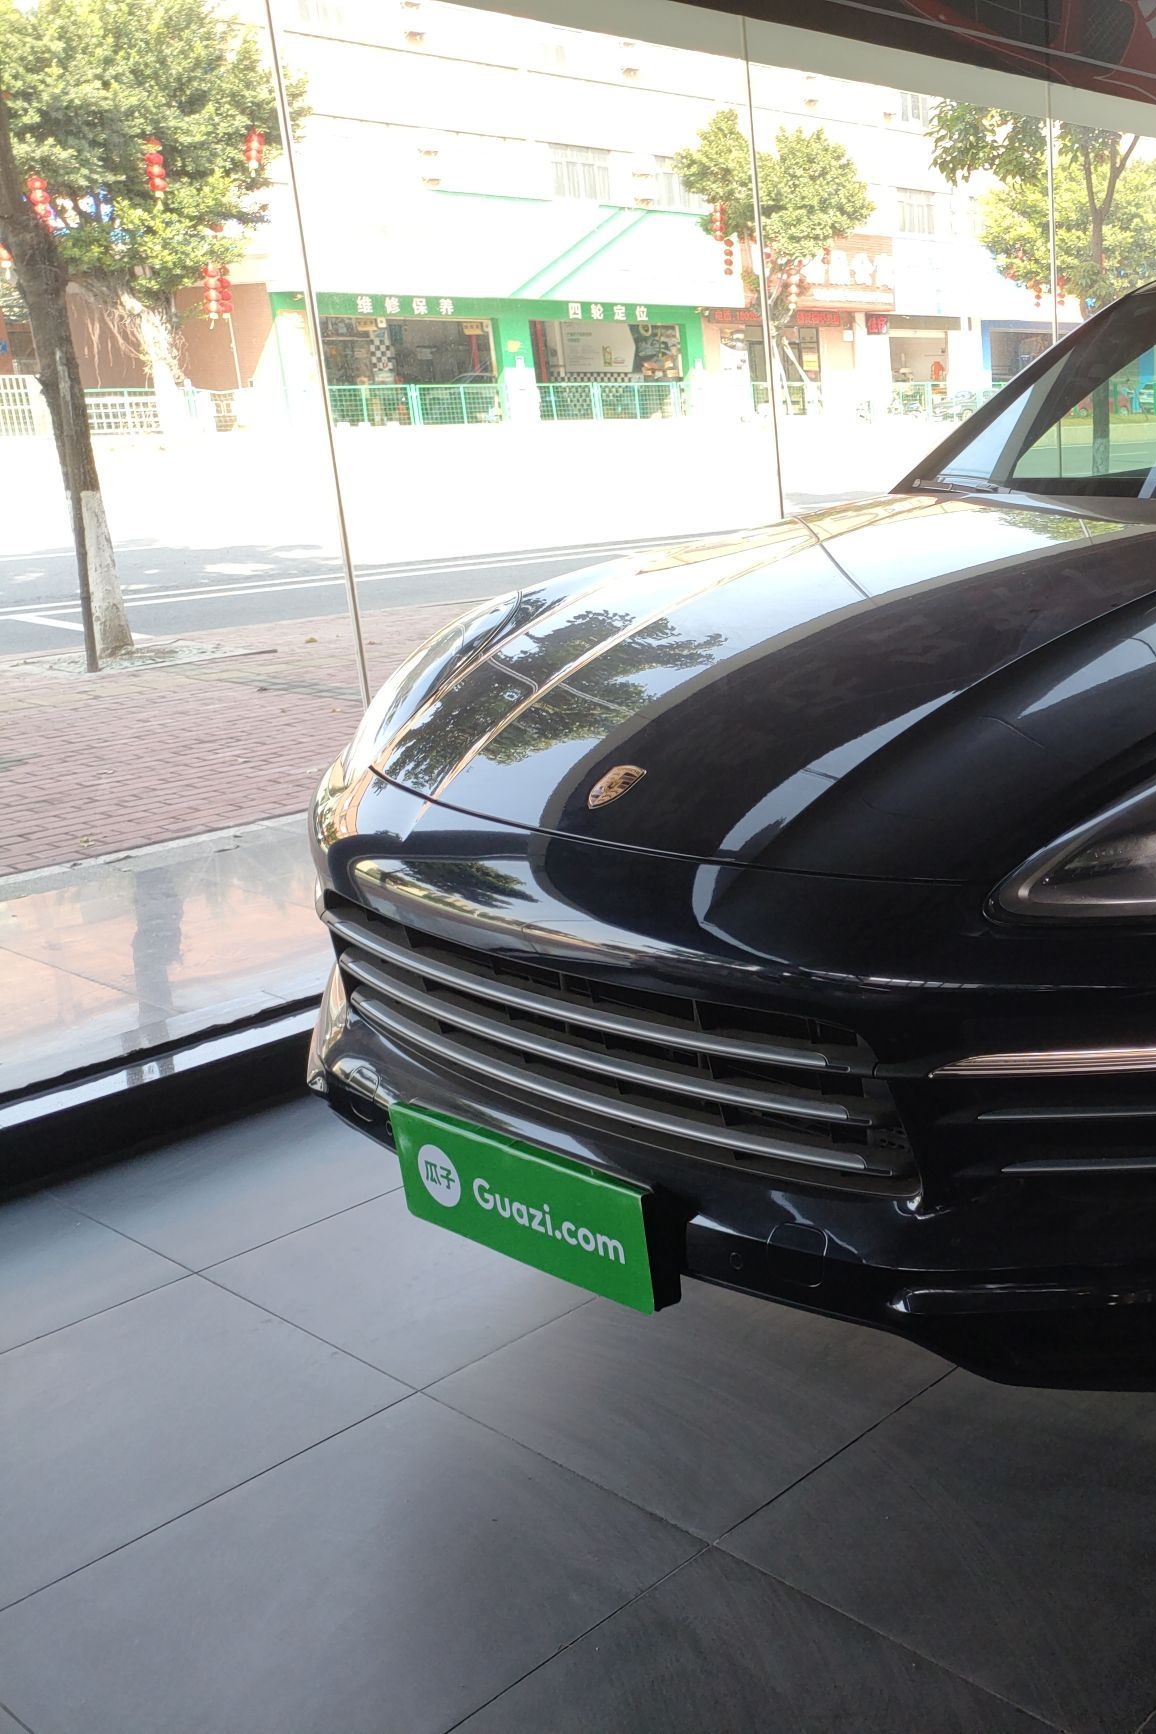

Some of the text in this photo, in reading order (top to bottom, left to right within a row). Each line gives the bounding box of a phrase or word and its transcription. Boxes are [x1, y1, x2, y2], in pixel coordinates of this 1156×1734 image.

[356, 296, 455, 315] 维修保养
[568, 302, 649, 321] 四轮定位
[424, 1159, 456, 1190] 瓜子
[472, 1177, 626, 1265] Guazi.com
